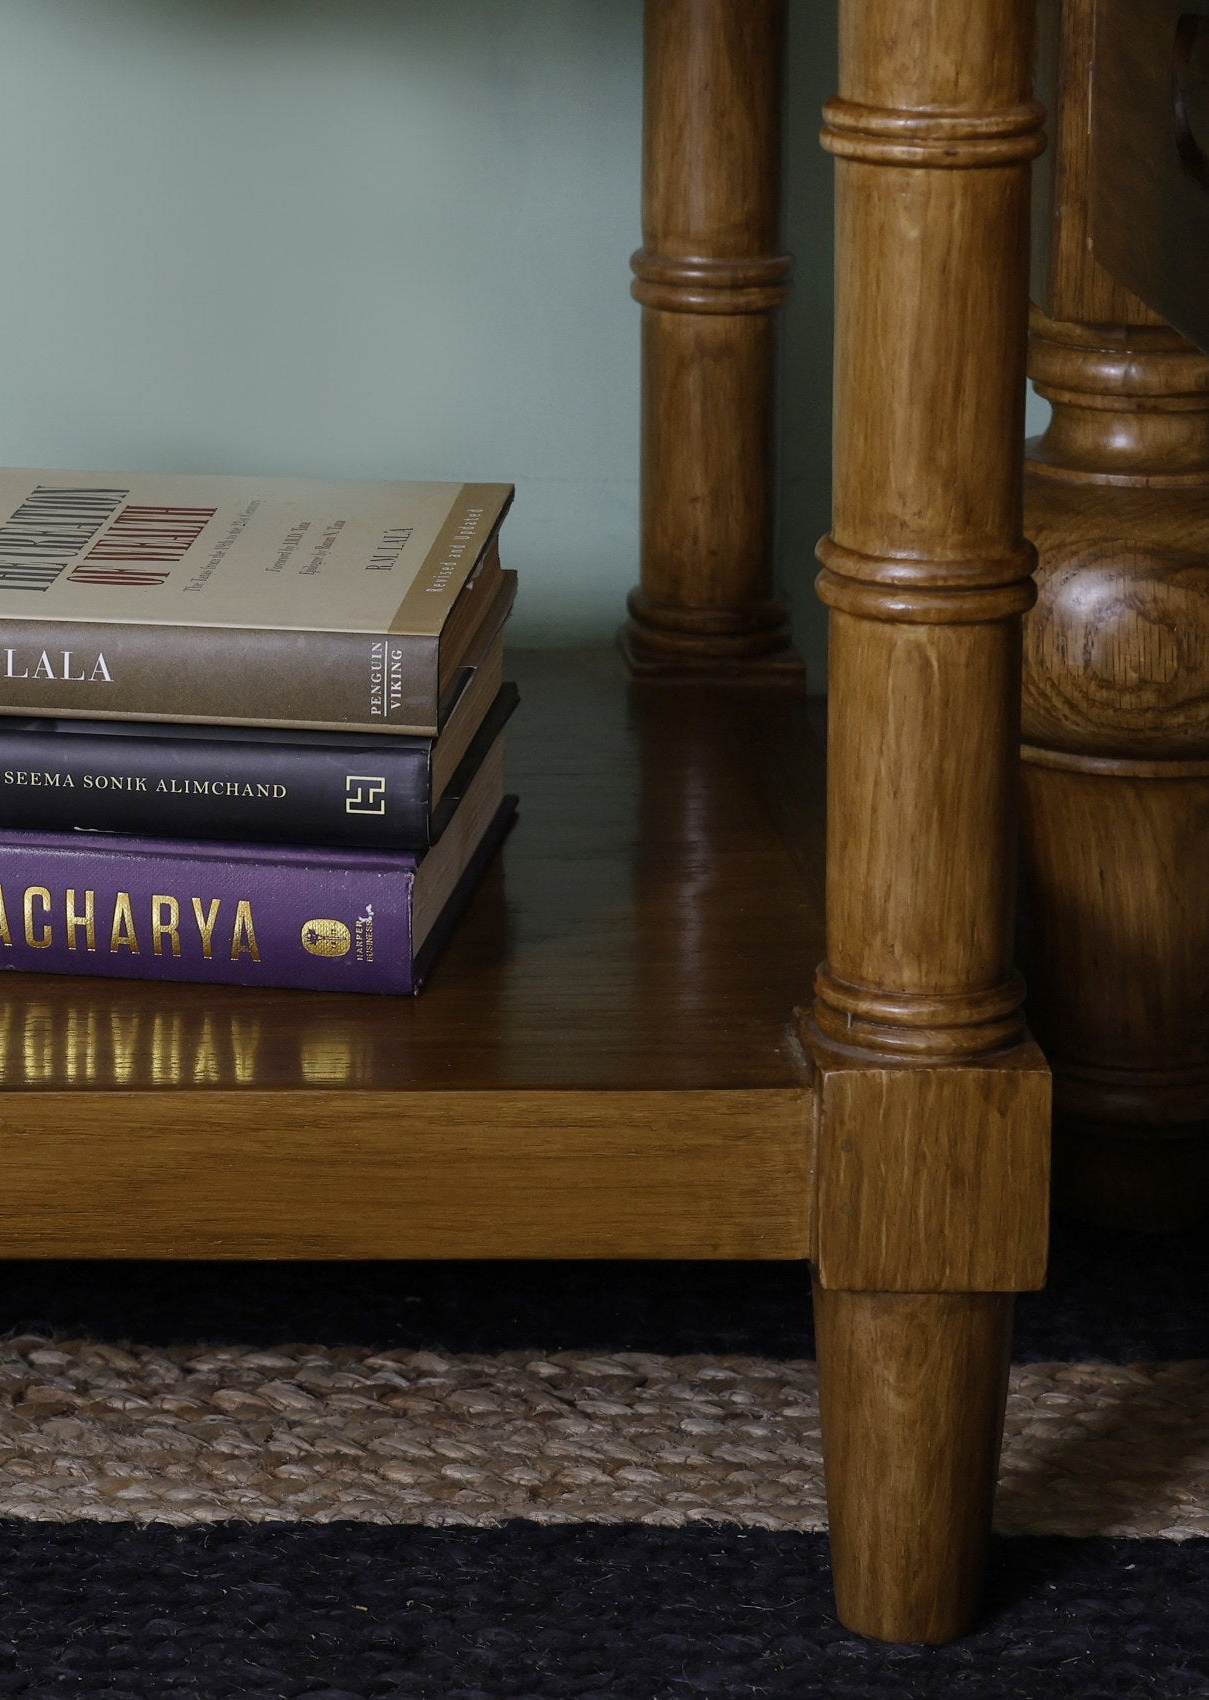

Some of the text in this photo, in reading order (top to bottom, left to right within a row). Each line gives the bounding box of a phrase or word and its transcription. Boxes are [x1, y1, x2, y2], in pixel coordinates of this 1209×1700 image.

[66, 504, 218, 586] OF WEALTH
[425, 508, 483, 592] Revised and Updated
[4, 649, 114, 682] LALA
[371, 642, 382, 715] PENGUIN
[391, 650, 402, 709] VIKING
[4, 771, 287, 799] SEEMA SONIK ALIMCHAND
[355, 920, 364, 961] HARPER
[366, 919, 374, 962] BUSINESS
